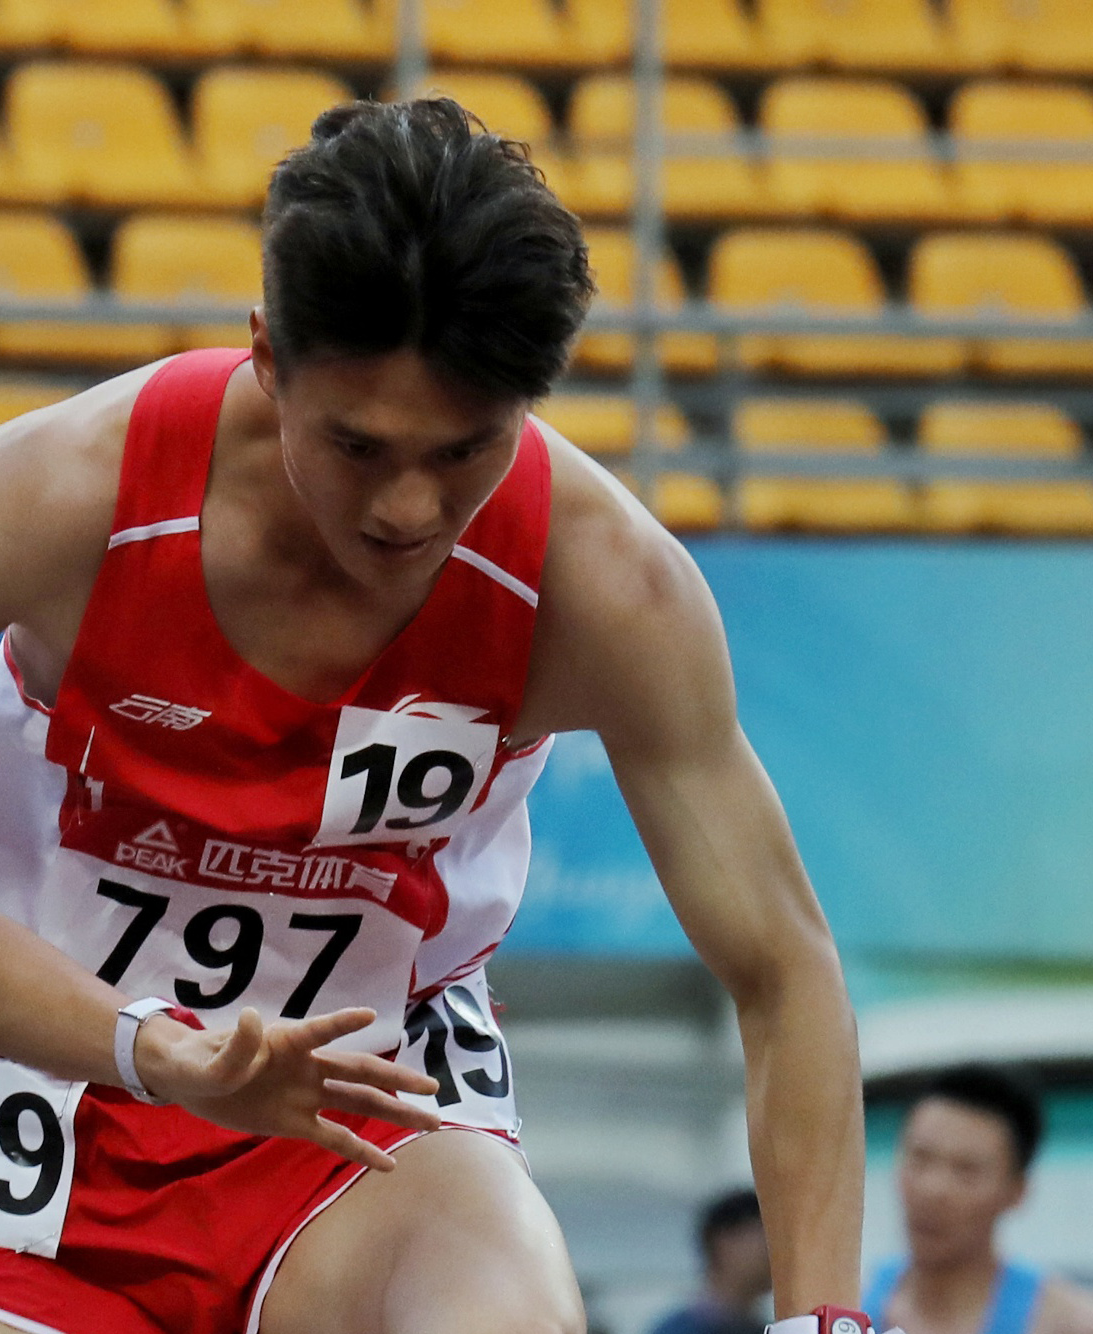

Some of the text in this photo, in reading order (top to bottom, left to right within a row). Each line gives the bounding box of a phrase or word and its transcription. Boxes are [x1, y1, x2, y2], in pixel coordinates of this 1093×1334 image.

[108, 694, 212, 730] 云南
[340, 743, 475, 834] 19
[114, 842, 193, 879] PEAK
[96, 878, 363, 1020] 797
[404, 985, 510, 1108] 19
